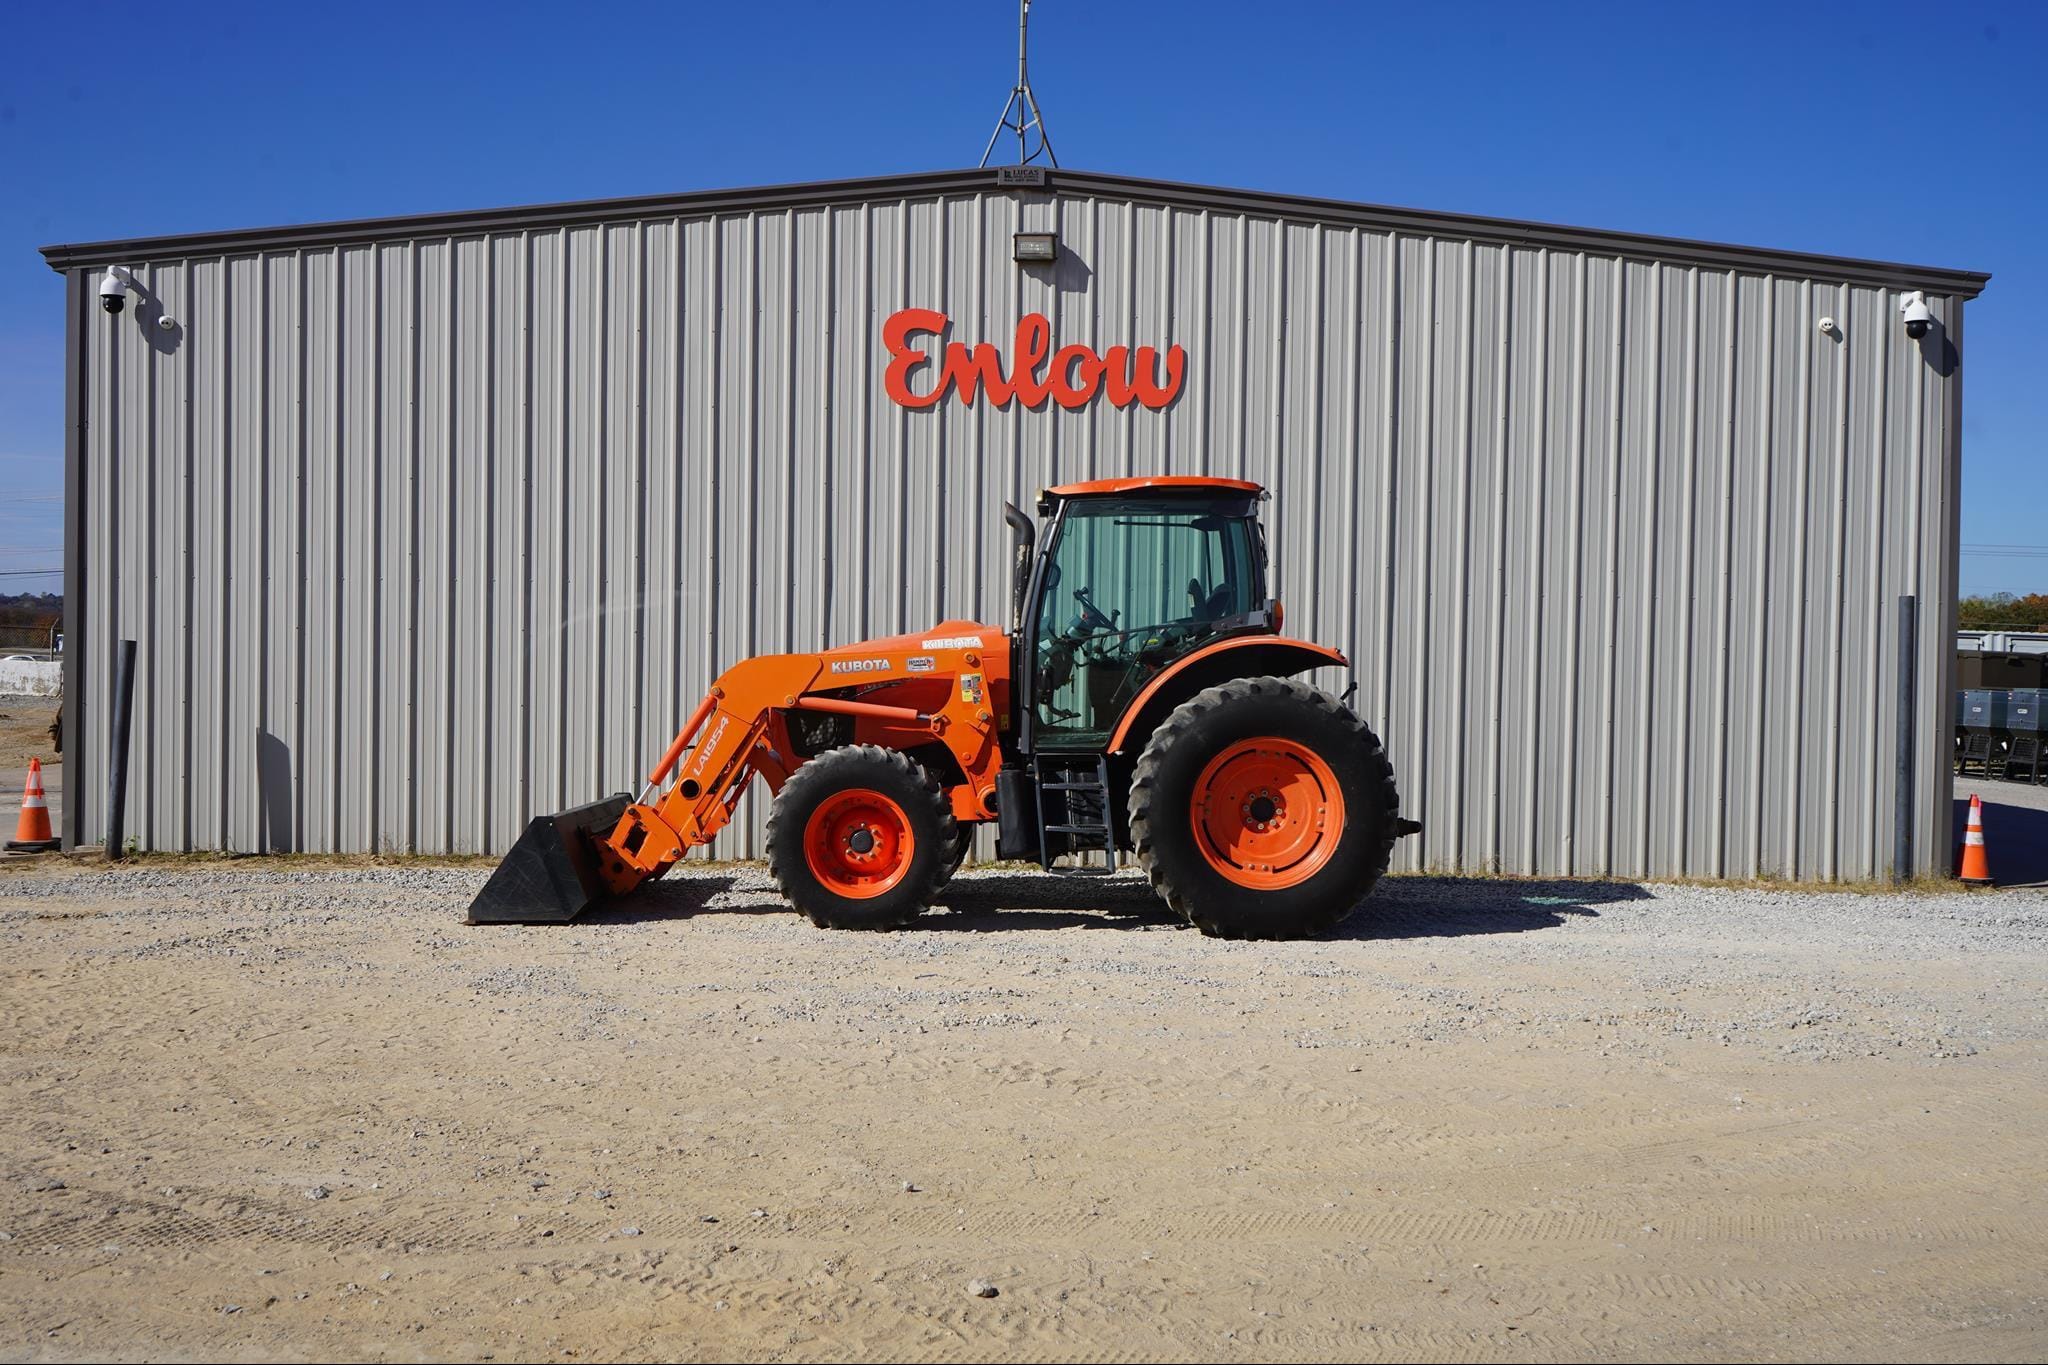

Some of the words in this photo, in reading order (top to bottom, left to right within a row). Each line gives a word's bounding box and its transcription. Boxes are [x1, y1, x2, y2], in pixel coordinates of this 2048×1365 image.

[883, 309, 1184, 408] Enlow
[922, 637, 983, 649] KUBOTA
[831, 659, 892, 673] KUBOTA
[693, 716, 729, 776] LA1954
